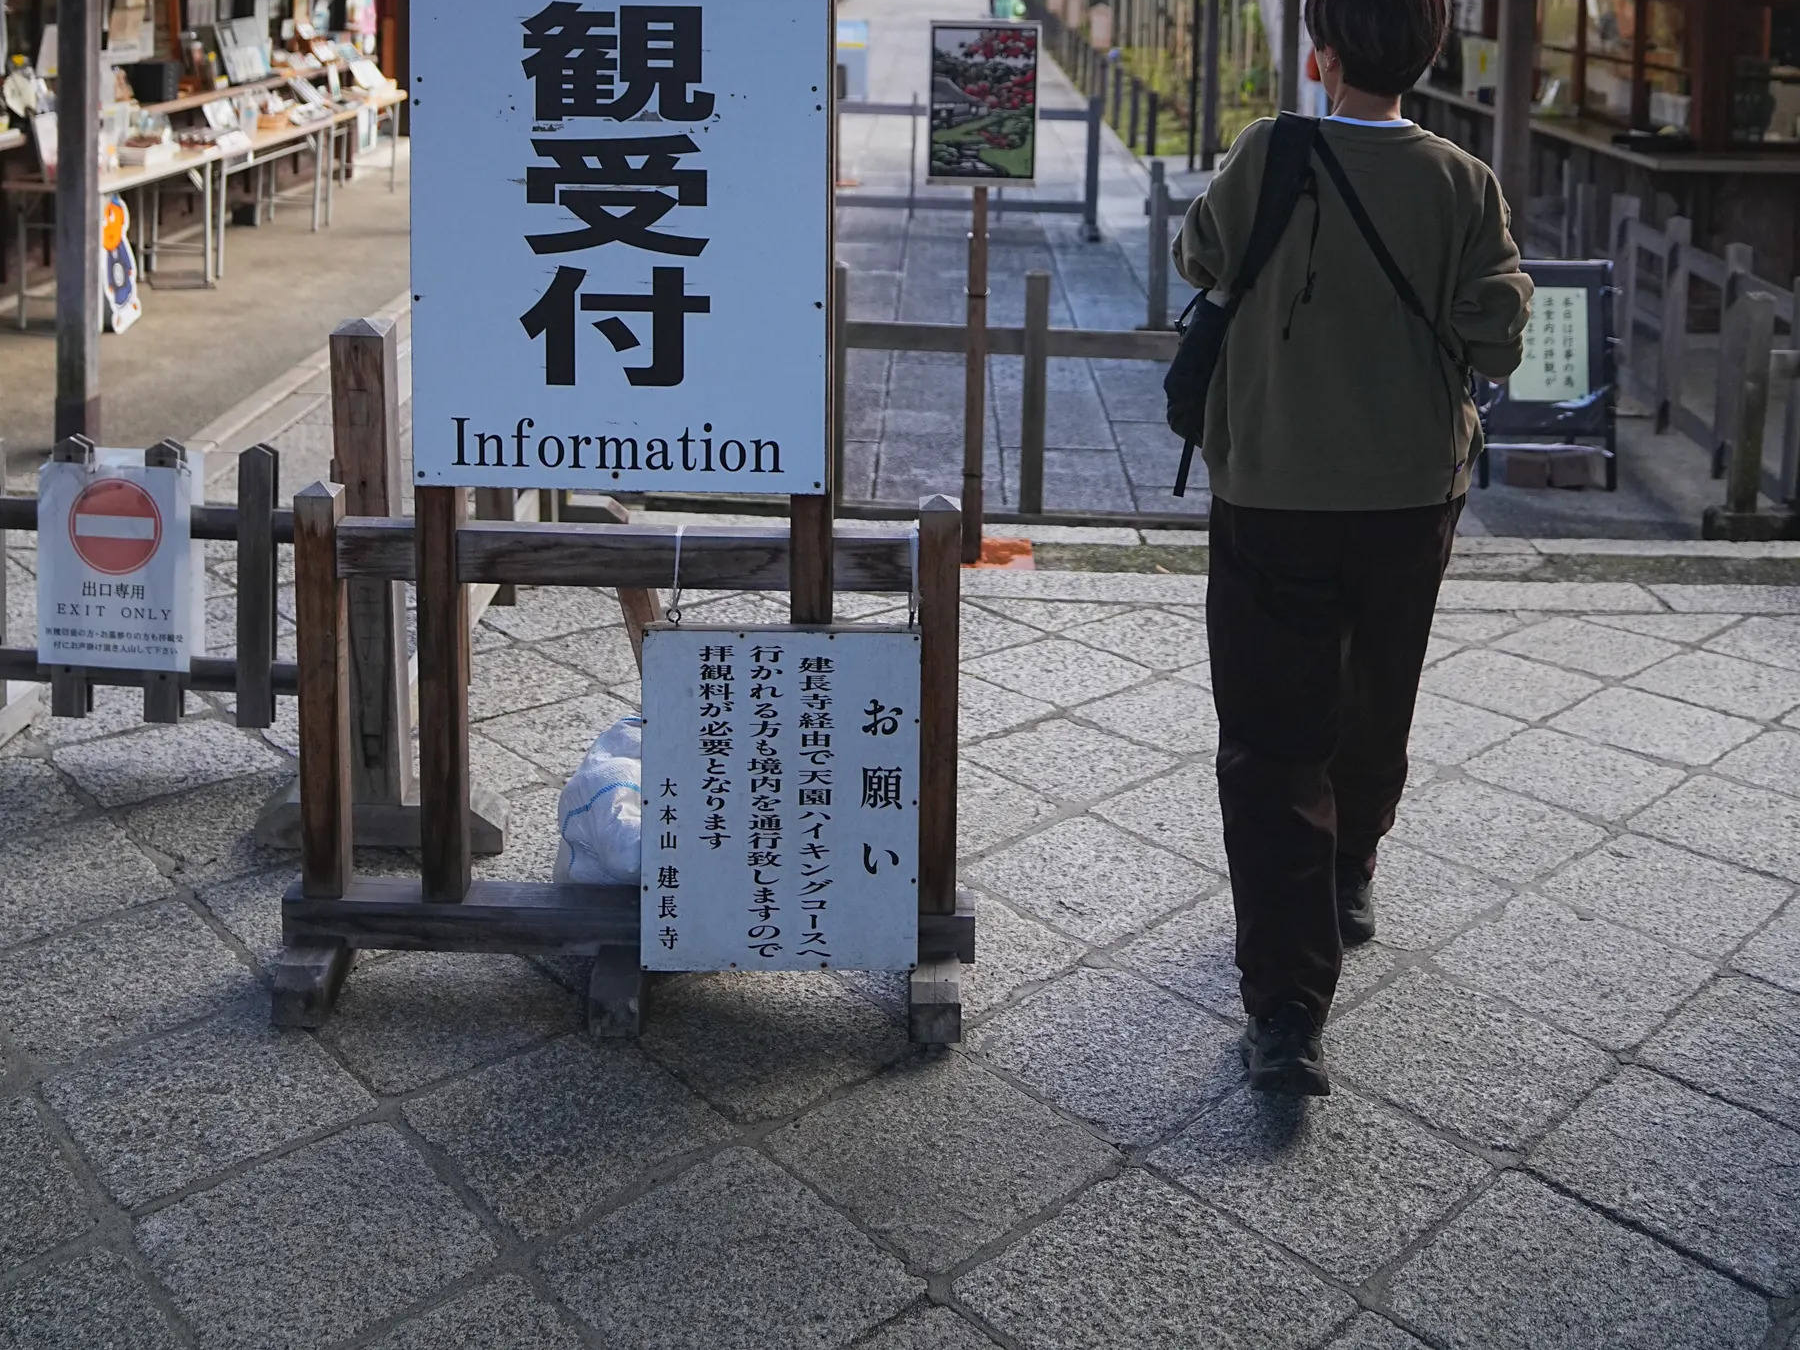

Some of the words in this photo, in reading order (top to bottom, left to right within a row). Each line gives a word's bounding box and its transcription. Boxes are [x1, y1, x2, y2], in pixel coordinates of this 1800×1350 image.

[451, 417, 785, 473] Information
[57, 603, 106, 617] EXIT
[121, 606, 172, 621] ONLY
[82, 580, 145, 600] 出口専用
[698, 645, 735, 850] 拝観料が必要となります
[747, 645, 784, 958] 行かれる方も境内を通行致しますので
[796, 656, 835, 958] 建長寺経由で天園ハイキングコースへ
